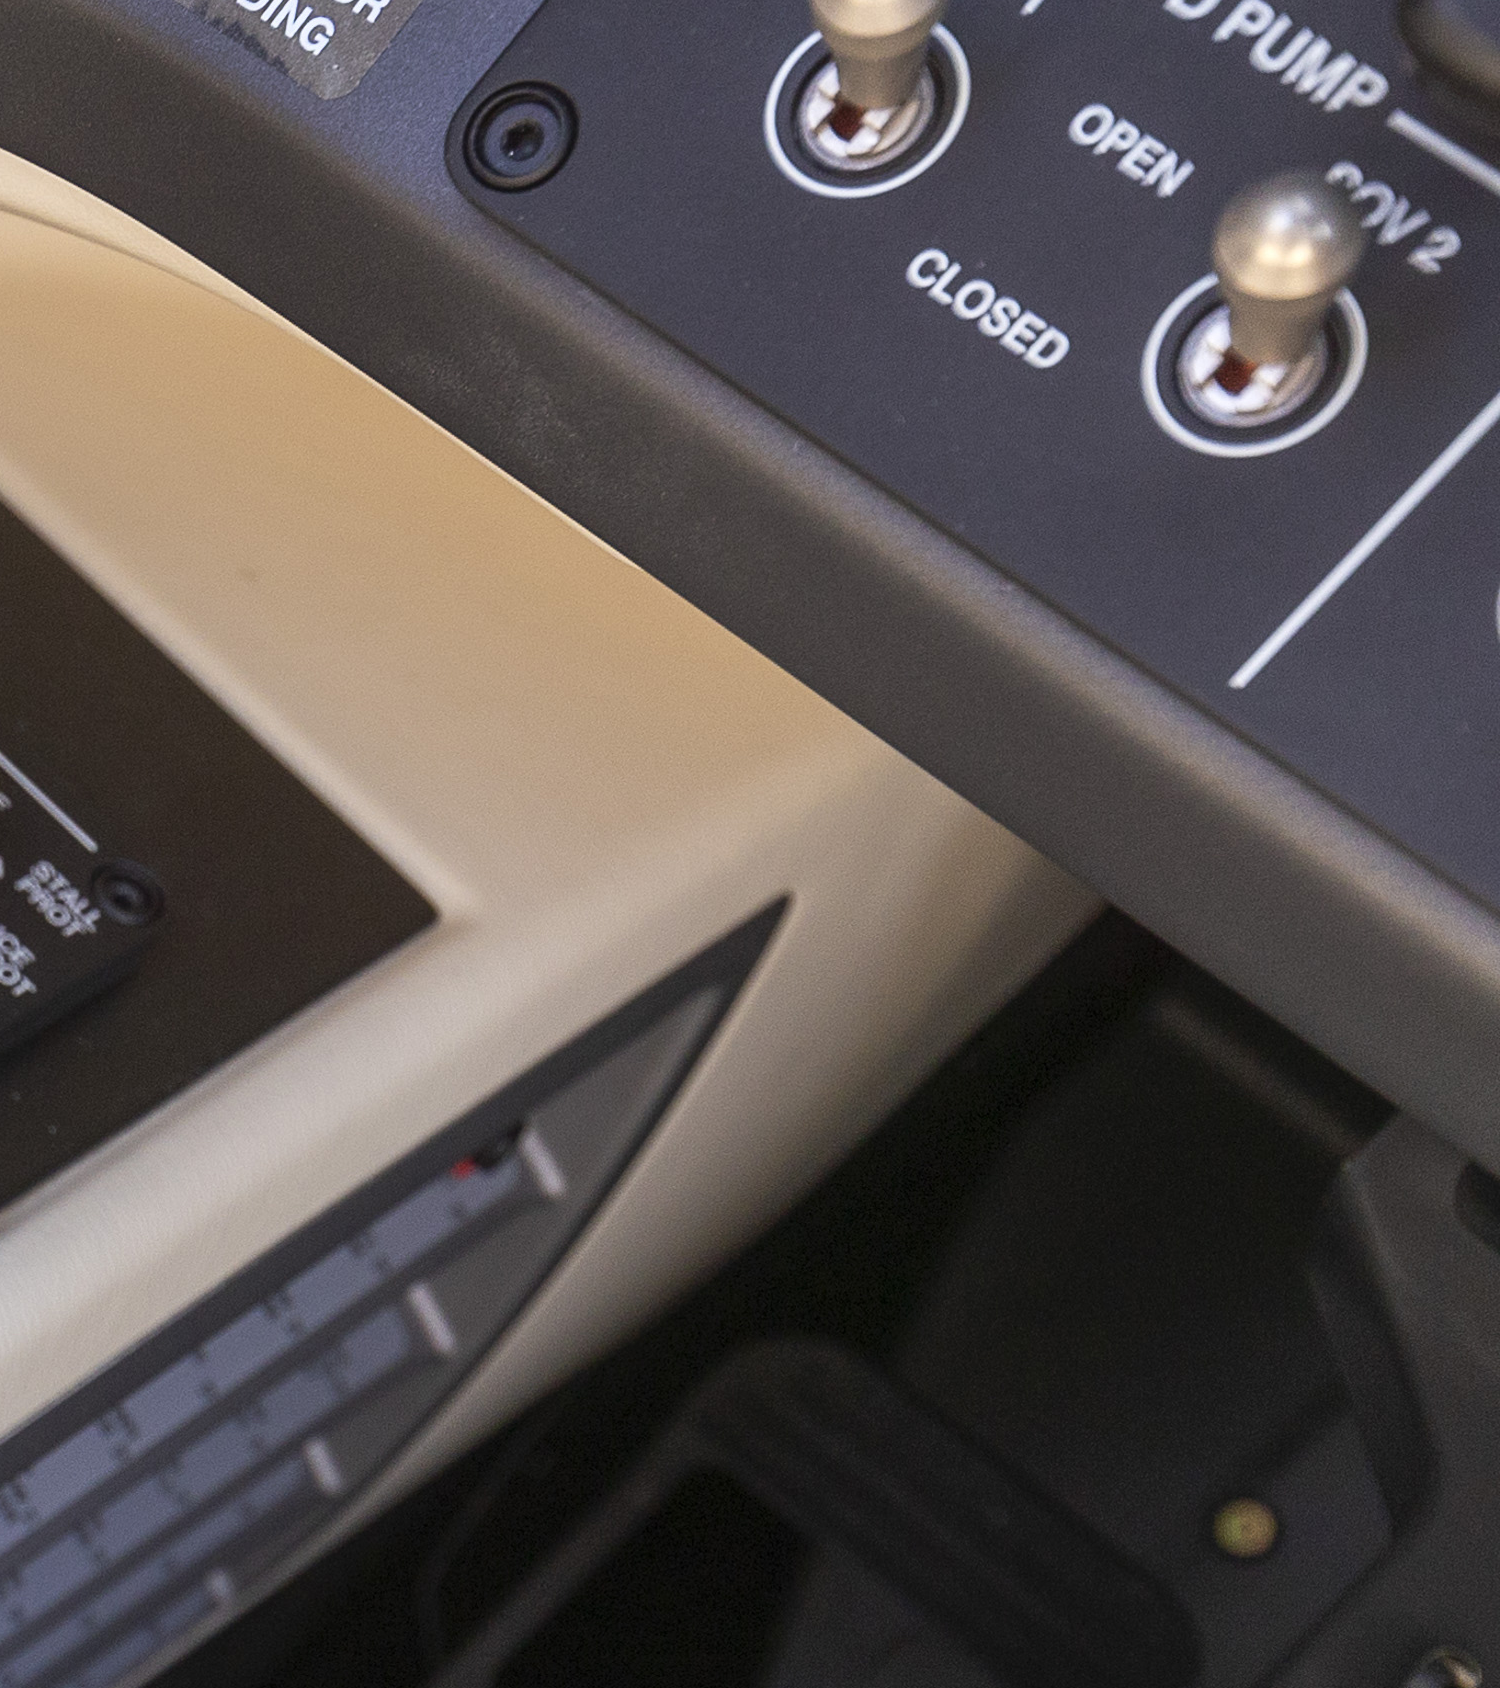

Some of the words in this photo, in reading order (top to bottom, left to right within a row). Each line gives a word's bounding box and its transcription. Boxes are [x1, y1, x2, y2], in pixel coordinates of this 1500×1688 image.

[1211, 0, 1389, 112] PUMP
[1069, 104, 1194, 197] OPEN
[1408, 226, 1462, 274] 2
[906, 248, 1069, 368] CLOSED
